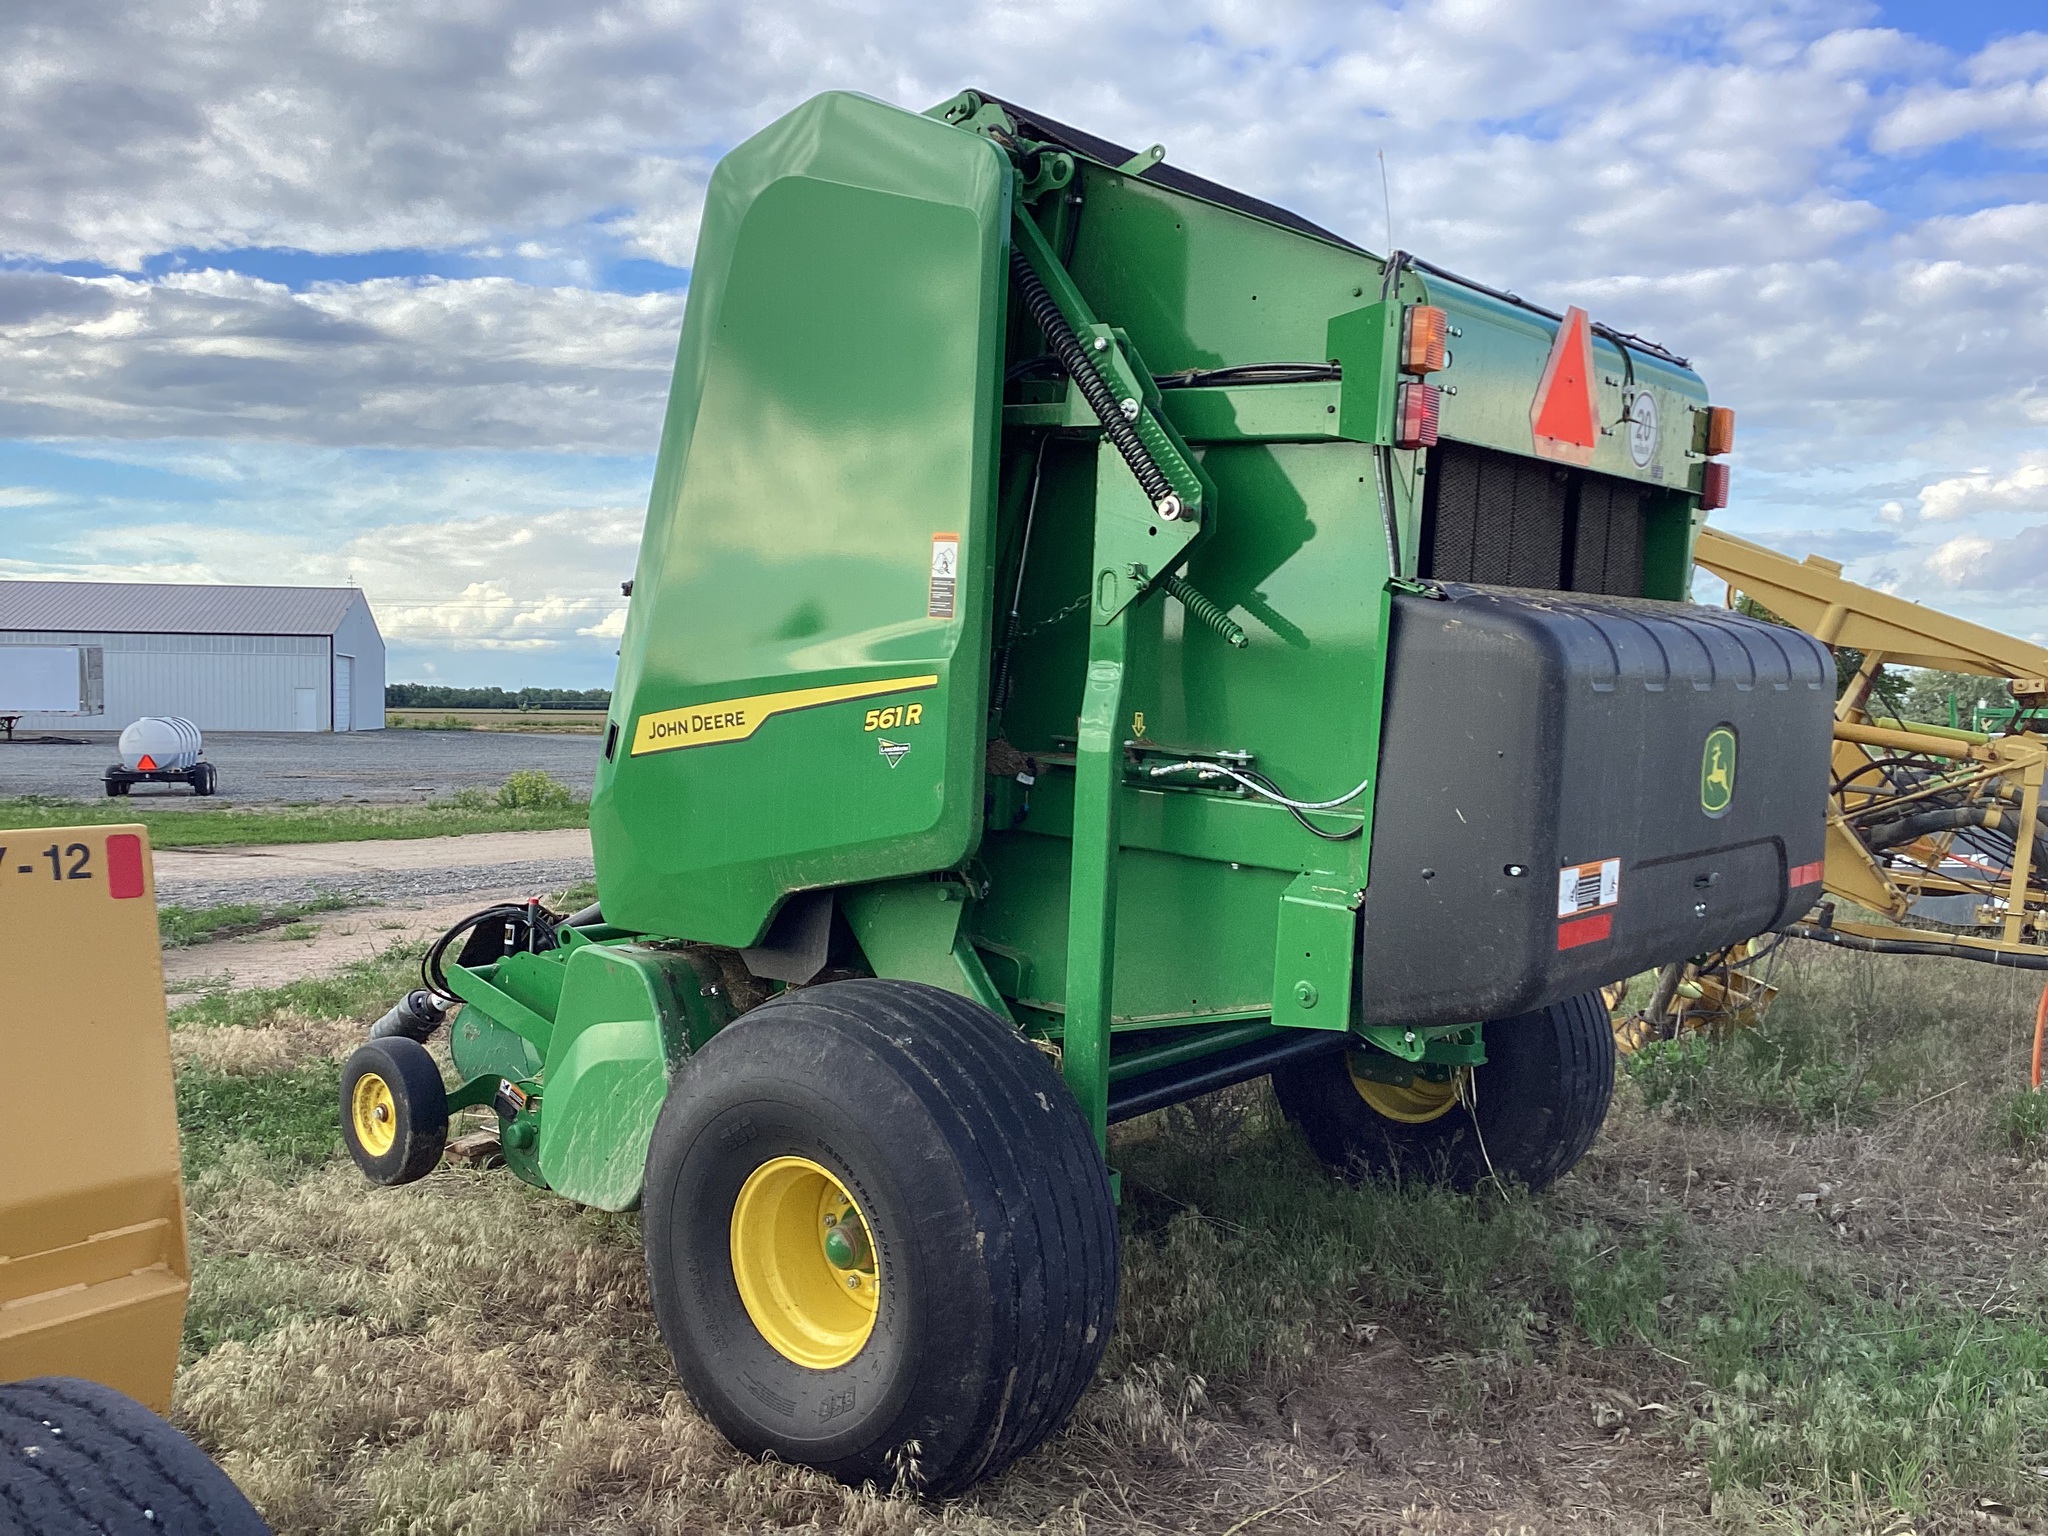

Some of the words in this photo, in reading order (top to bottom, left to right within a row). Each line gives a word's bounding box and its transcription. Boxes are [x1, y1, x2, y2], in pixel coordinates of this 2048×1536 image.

[1636, 408, 1652, 441] 20
[649, 719, 688, 740] JOHN
[692, 710, 746, 733] DEERE
[863, 702, 923, 732] 561R
